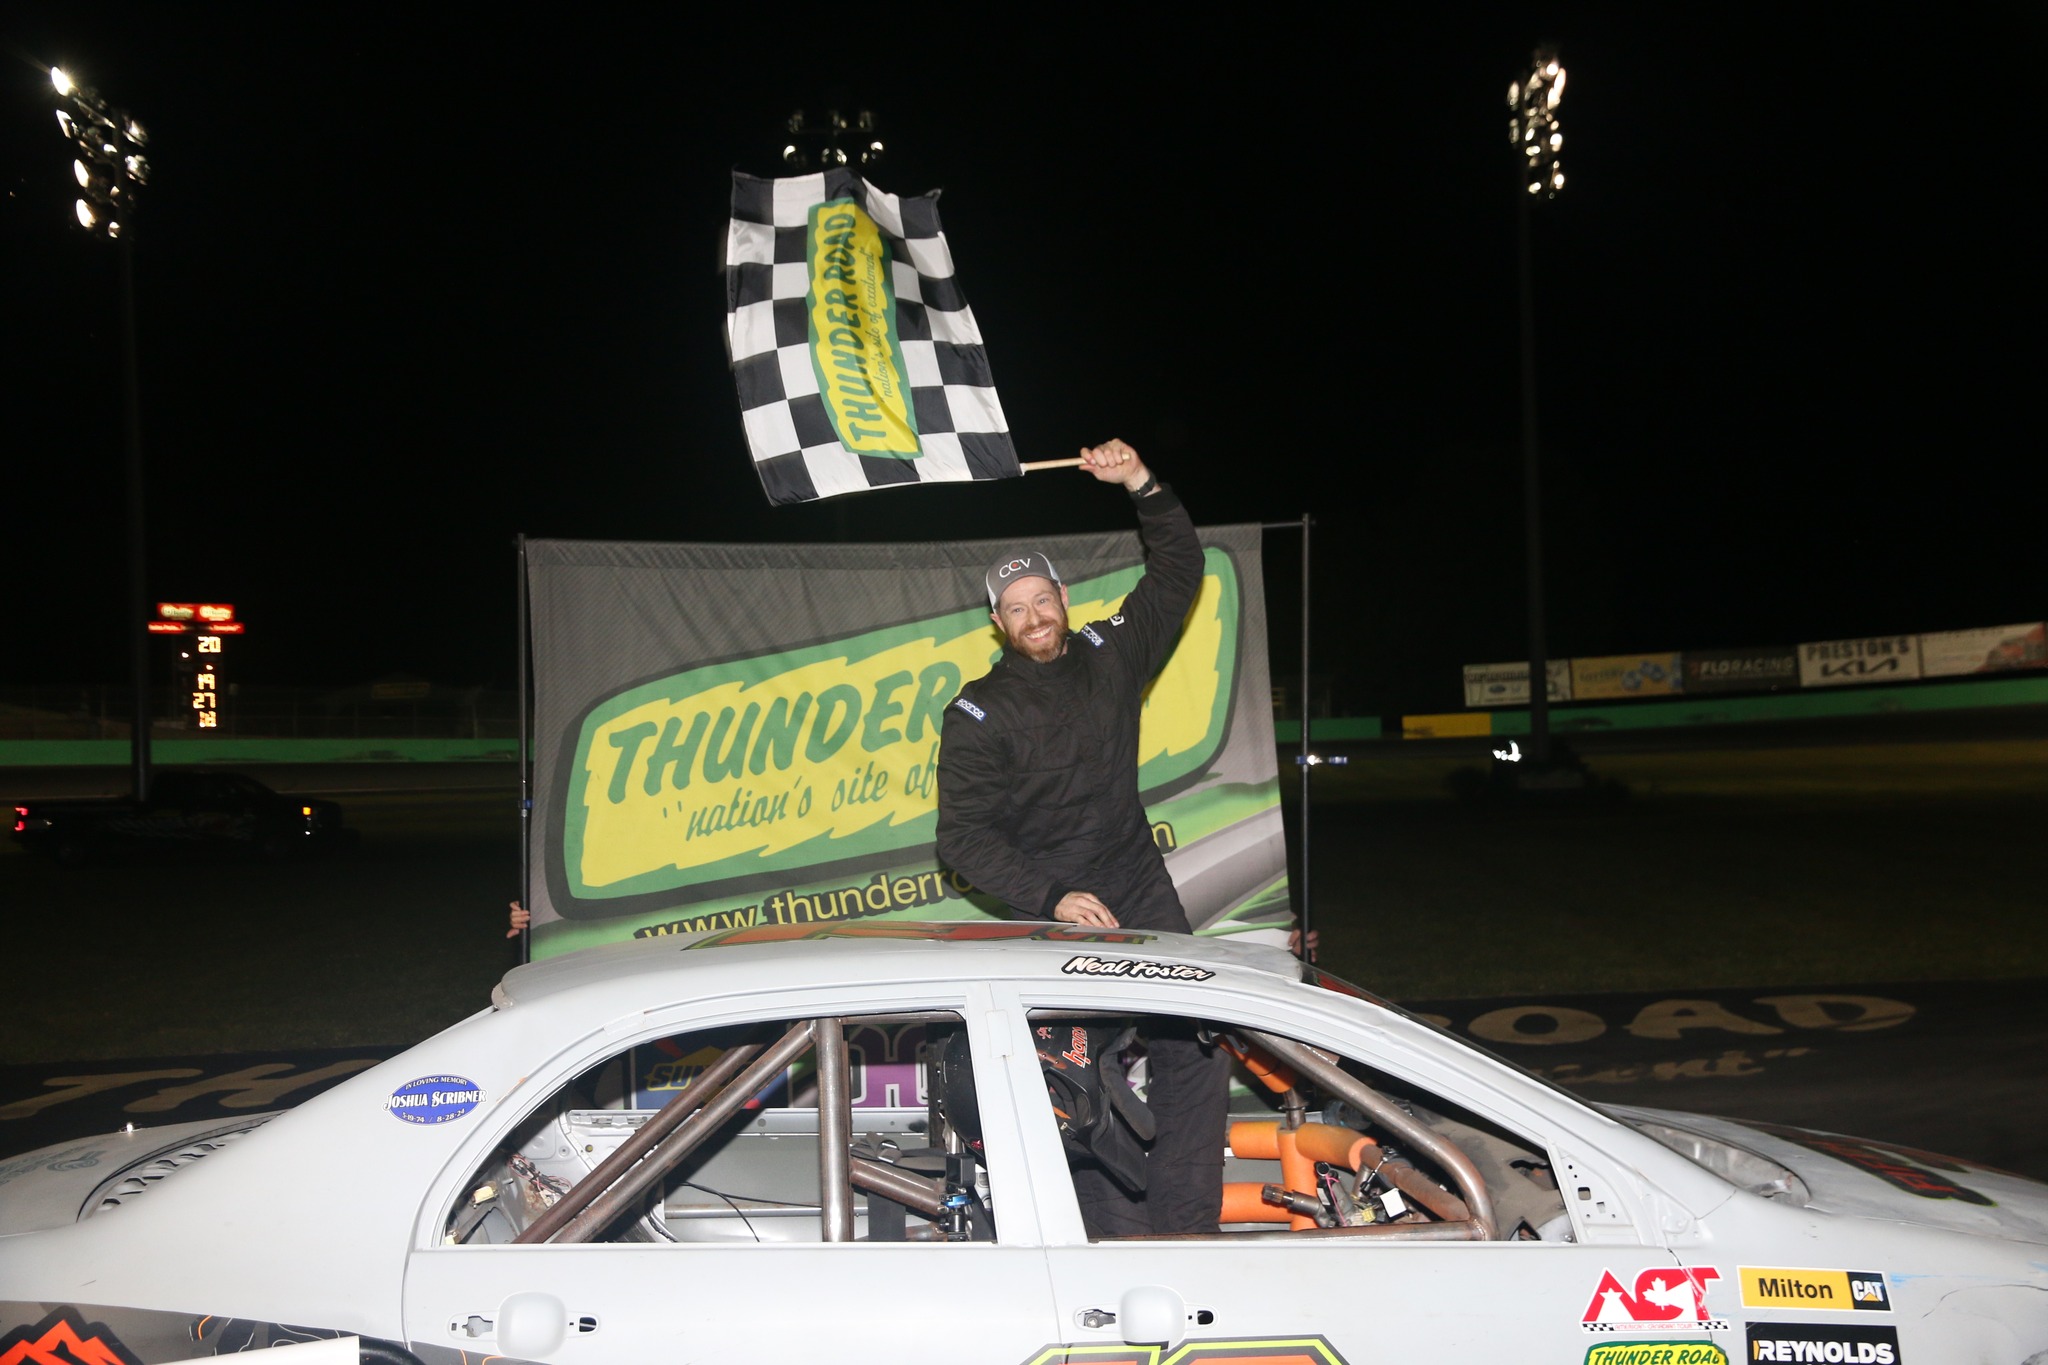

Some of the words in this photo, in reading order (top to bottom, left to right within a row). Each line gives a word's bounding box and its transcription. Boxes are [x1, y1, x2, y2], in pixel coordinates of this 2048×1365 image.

[823, 213, 857, 285] ROAD
[861, 307, 882, 323] of
[865, 327, 882, 347] site
[826, 289, 887, 441] THUNDER
[999, 558, 1031, 578] CCV
[198, 636, 221, 652] 20
[1807, 637, 1909, 660] PRESTON'S
[1700, 656, 1795, 675] FLORACING
[1822, 658, 1898, 677] KIA
[193, 692, 216, 708] 27
[956, 698, 985, 720] sparco
[608, 661, 961, 804] THUNDER
[831, 761, 888, 812] site
[904, 741, 938, 800] of
[1065, 956, 1131, 974] Neal
[1130, 961, 1213, 979] Foster
[1420, 994, 1916, 1046] OAD
[413, 1077, 439, 1087] LOVING
[441, 1076, 468, 1086] MEMORY
[383, 1093, 428, 1110] JOSHUA
[432, 1090, 486, 1107] SCRIBNER
[436, 1108, 465, 1122] 8-28-24
[1582, 1268, 1721, 1321] ACT
[1758, 1278, 1833, 1299] Milton
[1851, 1280, 1884, 1302] CAT
[1594, 1350, 1673, 1365] THUNDER
[1758, 1340, 1895, 1365] REYNOLDS
